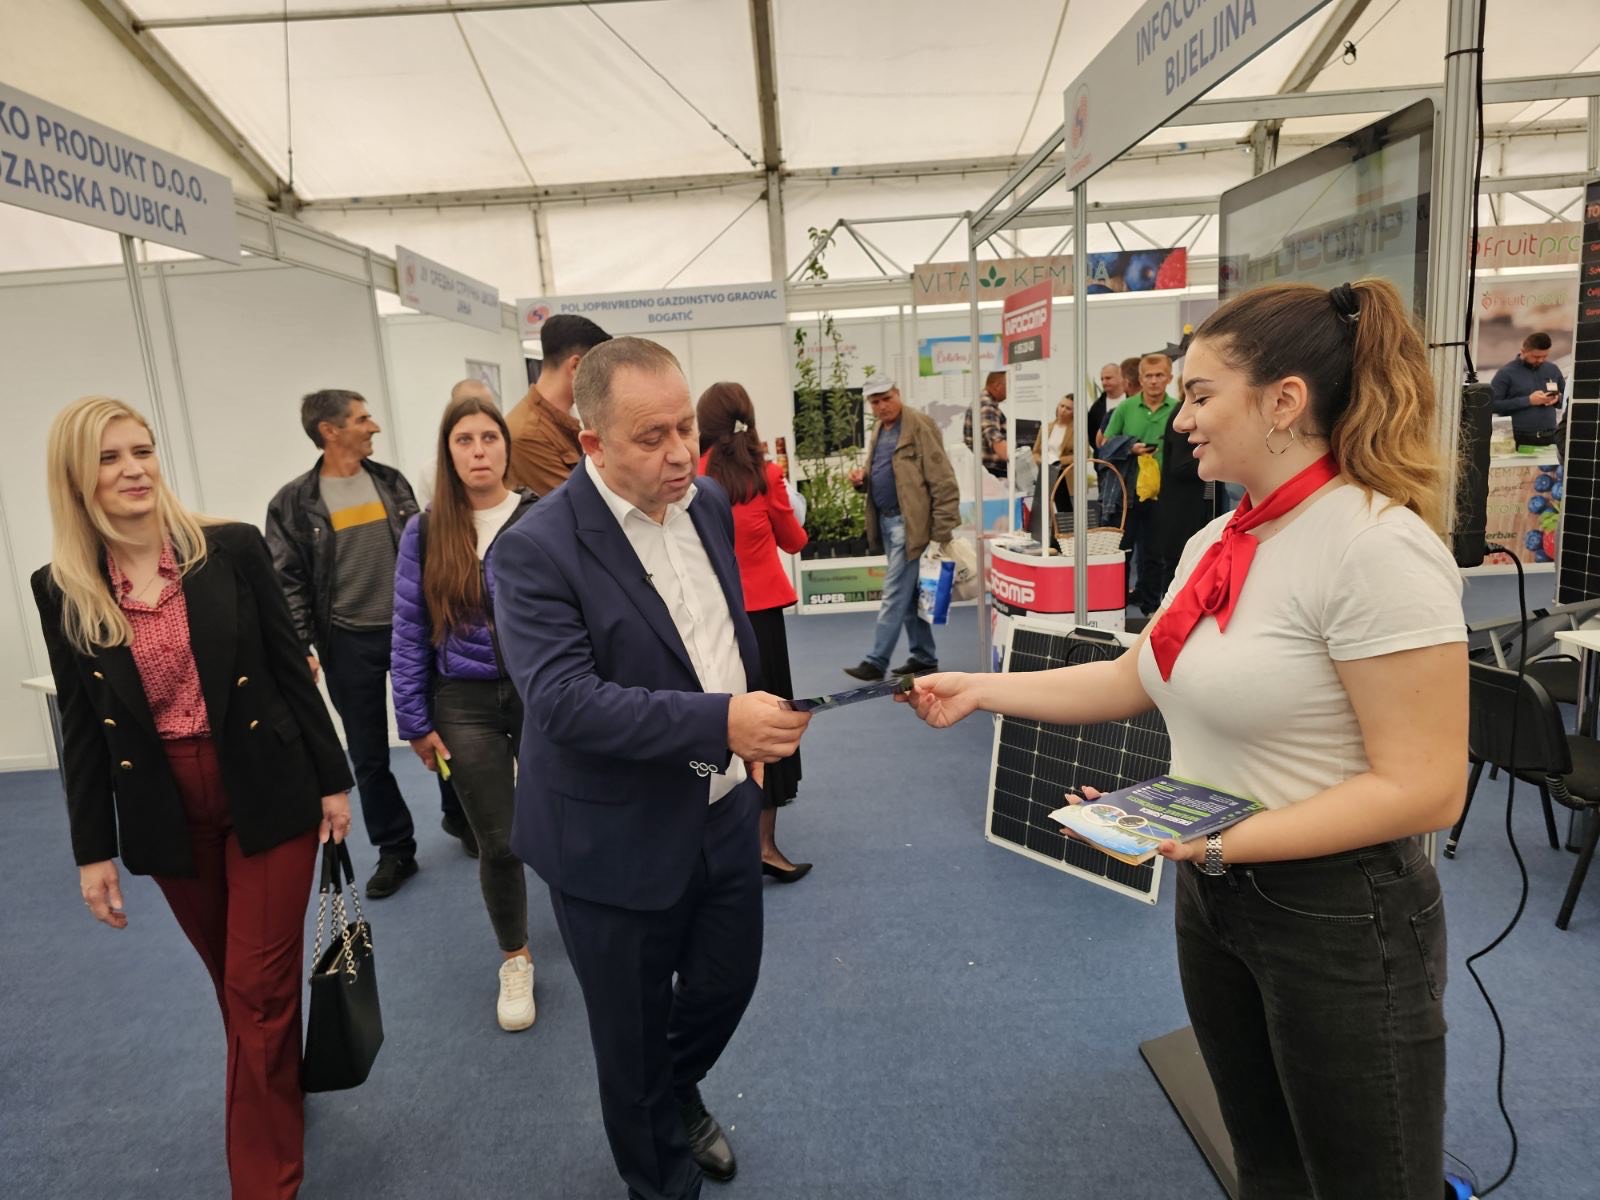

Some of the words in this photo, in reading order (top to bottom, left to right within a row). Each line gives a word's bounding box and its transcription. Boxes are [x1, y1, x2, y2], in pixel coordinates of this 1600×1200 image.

[1137, 0, 1205, 66] INFOCO
[1165, 0, 1257, 96] BIJELJINA
[36, 114, 147, 183] PRODUKT
[152, 160, 208, 205] D.O.O.
[0, 151, 107, 211] ZARSKA
[109, 186, 187, 235] DUBICA
[561, 298, 655, 313] POLJOPRIVREDNO
[656, 293, 725, 307] GAZDINSTVO
[727, 289, 778, 302] GRAOVAC
[918, 272, 969, 294] VITA
[648, 310, 694, 323] BOGATIĆ
